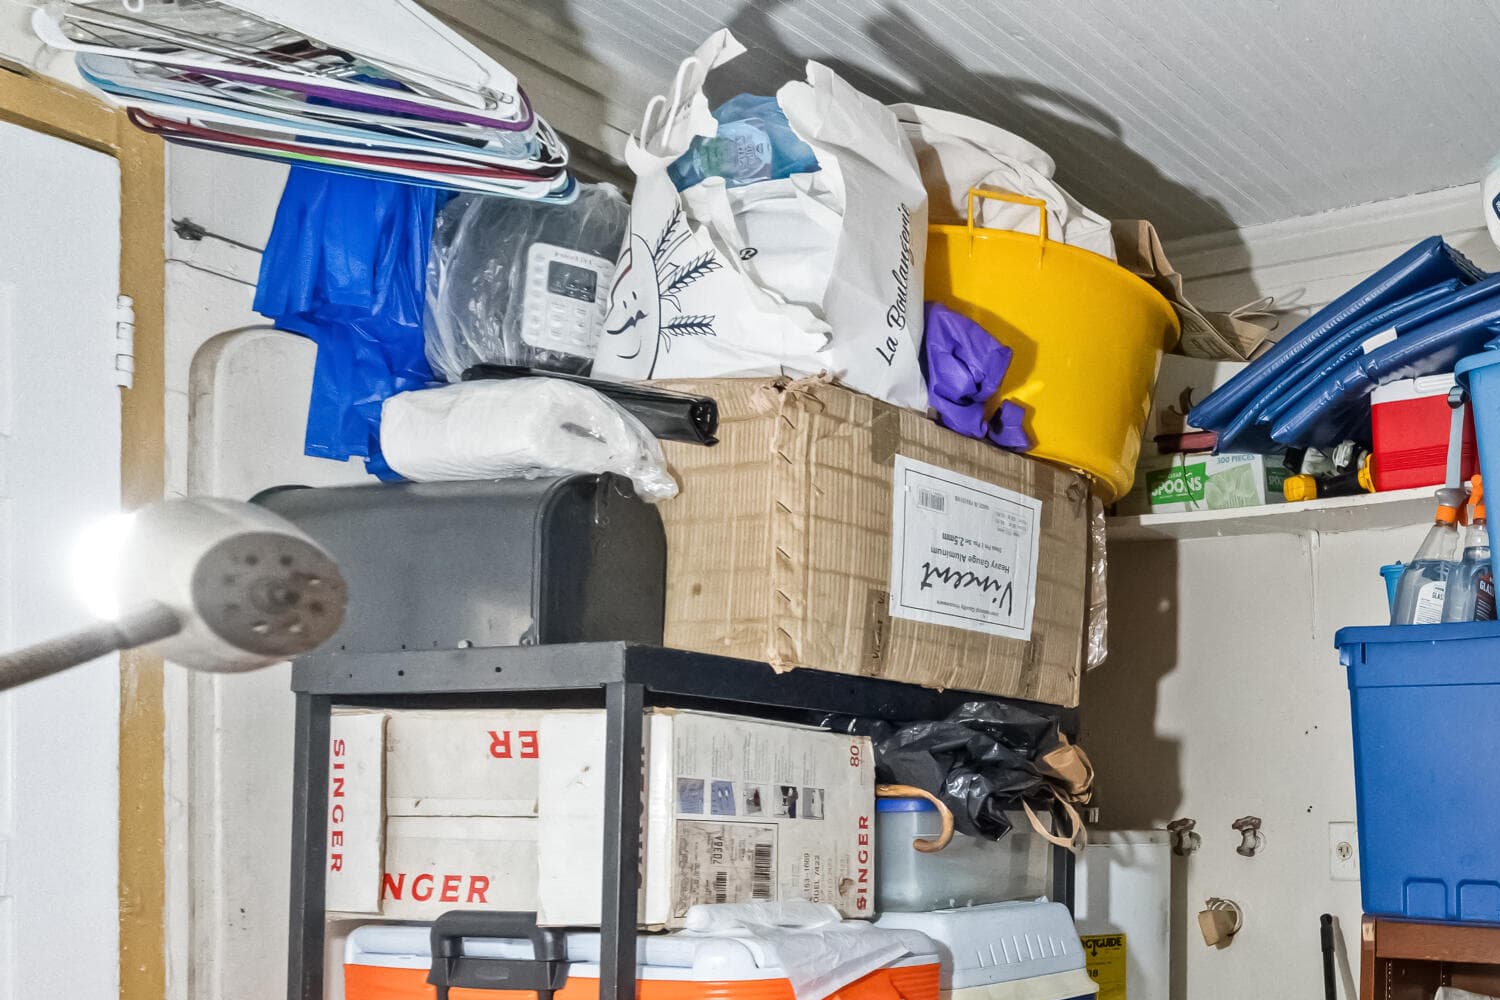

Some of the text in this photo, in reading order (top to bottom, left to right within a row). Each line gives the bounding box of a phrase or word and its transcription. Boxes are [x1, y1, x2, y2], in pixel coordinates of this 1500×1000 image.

[876, 203, 914, 366] La Boulangerie
[1216, 454, 1255, 465] 300 PIECES
[931, 546, 1010, 574] Heavy Gauge Aluminum
[921, 562, 1013, 617] Vincent
[850, 745, 859, 767] 80
[330, 739, 346, 873] SINGER
[857, 815, 870, 911] SINGER
[381, 873, 490, 904] NGER
